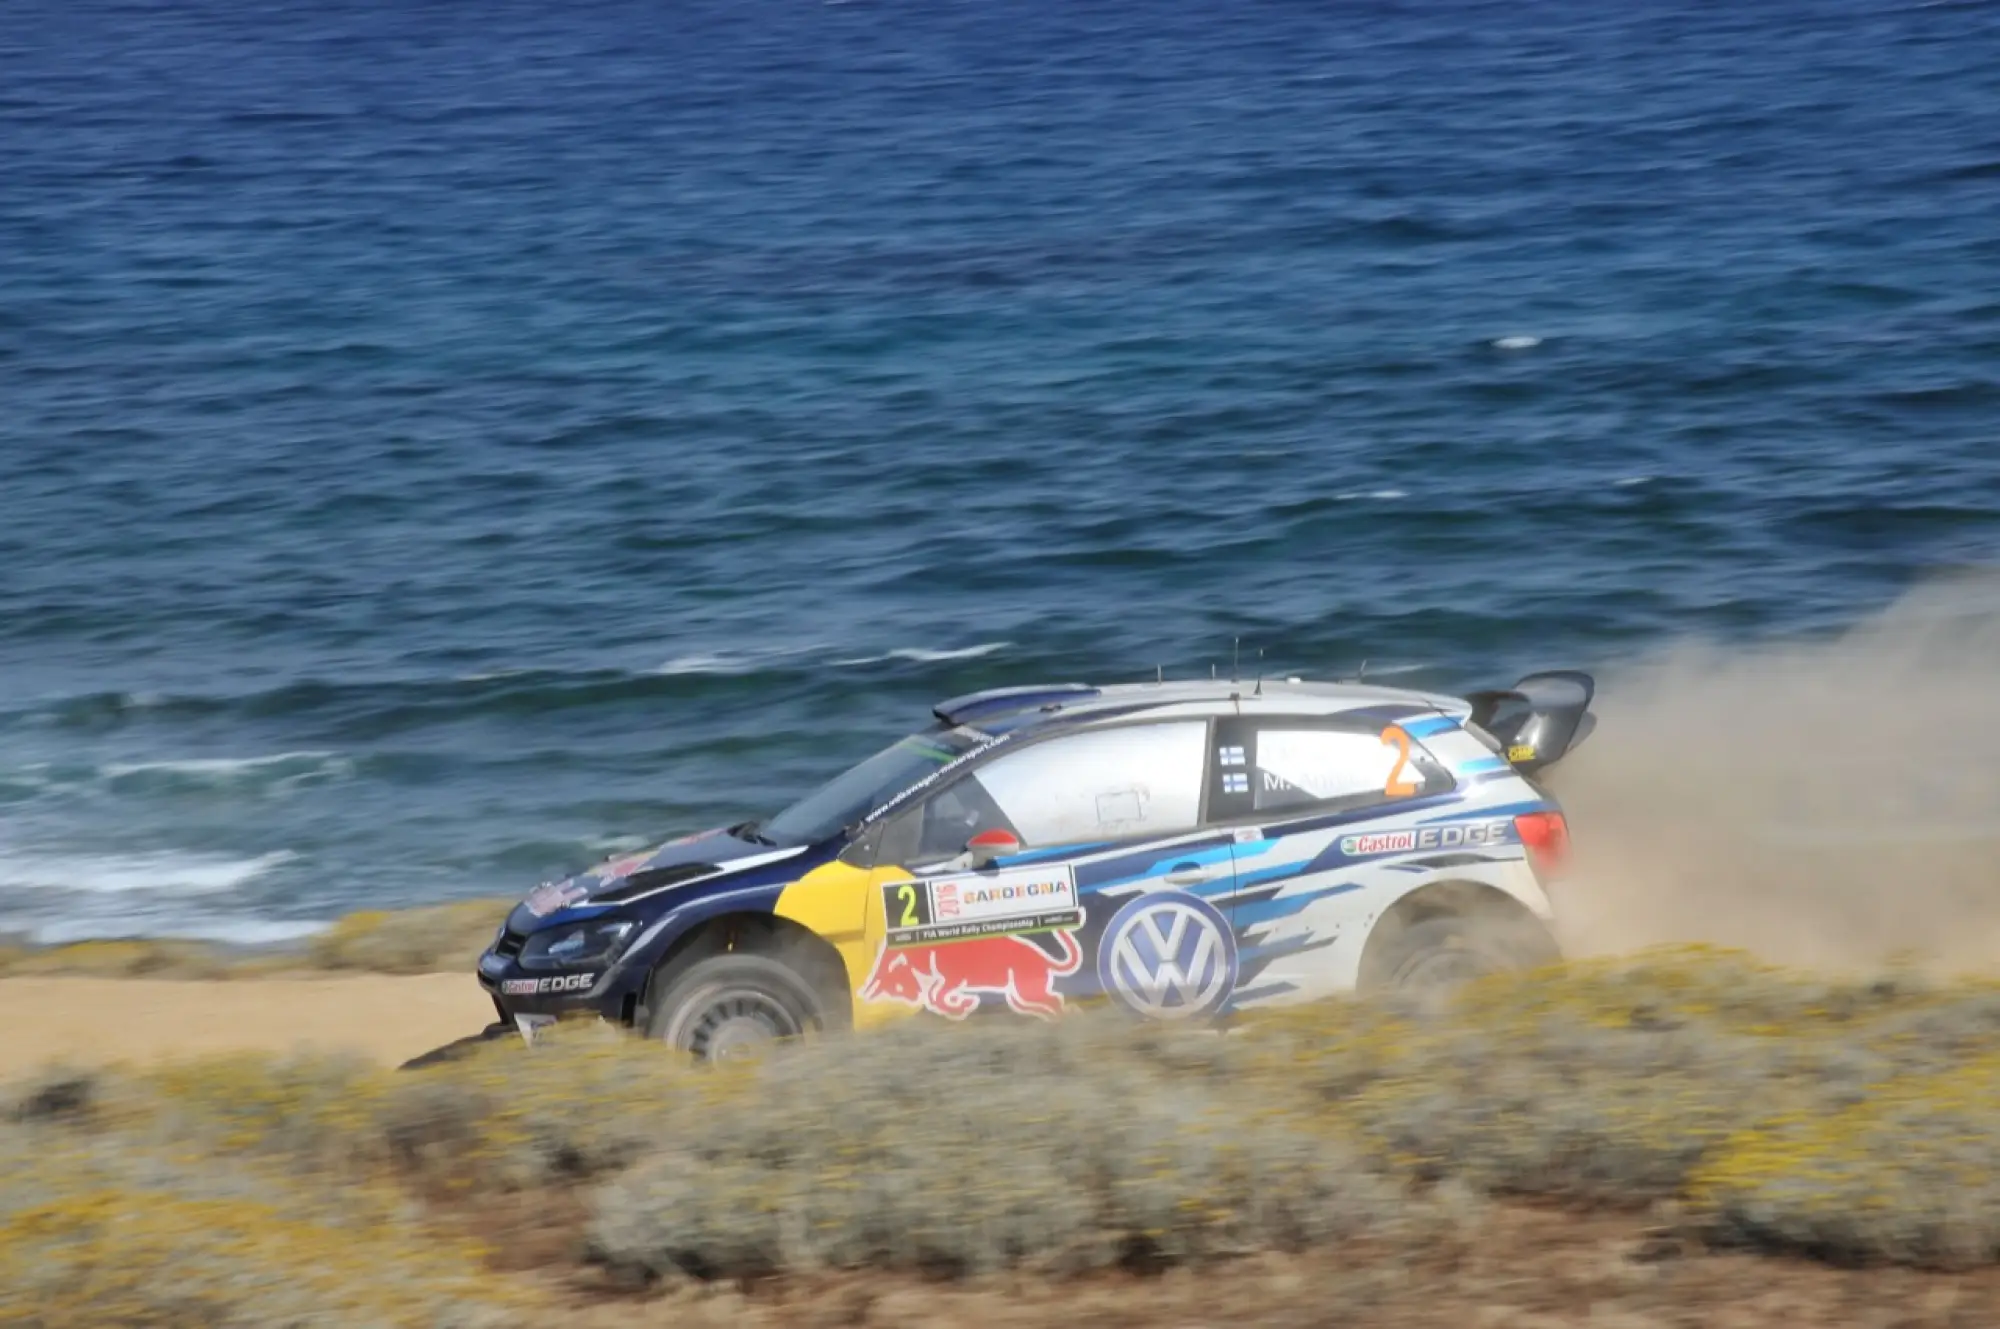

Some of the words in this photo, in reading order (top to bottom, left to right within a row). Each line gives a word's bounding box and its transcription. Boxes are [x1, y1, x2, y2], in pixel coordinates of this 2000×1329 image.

[1380, 724, 1416, 796] 2
[1358, 832, 1412, 853] Castrol
[1418, 822, 1508, 849] EDGE
[898, 884, 919, 927] 2
[963, 880, 1069, 905] SARDEGNA
[923, 928, 937, 939] FIA
[938, 926, 960, 938] World
[961, 923, 981, 937] Rally
[982, 919, 1034, 935] Championship
[539, 972, 595, 993] EDGE
